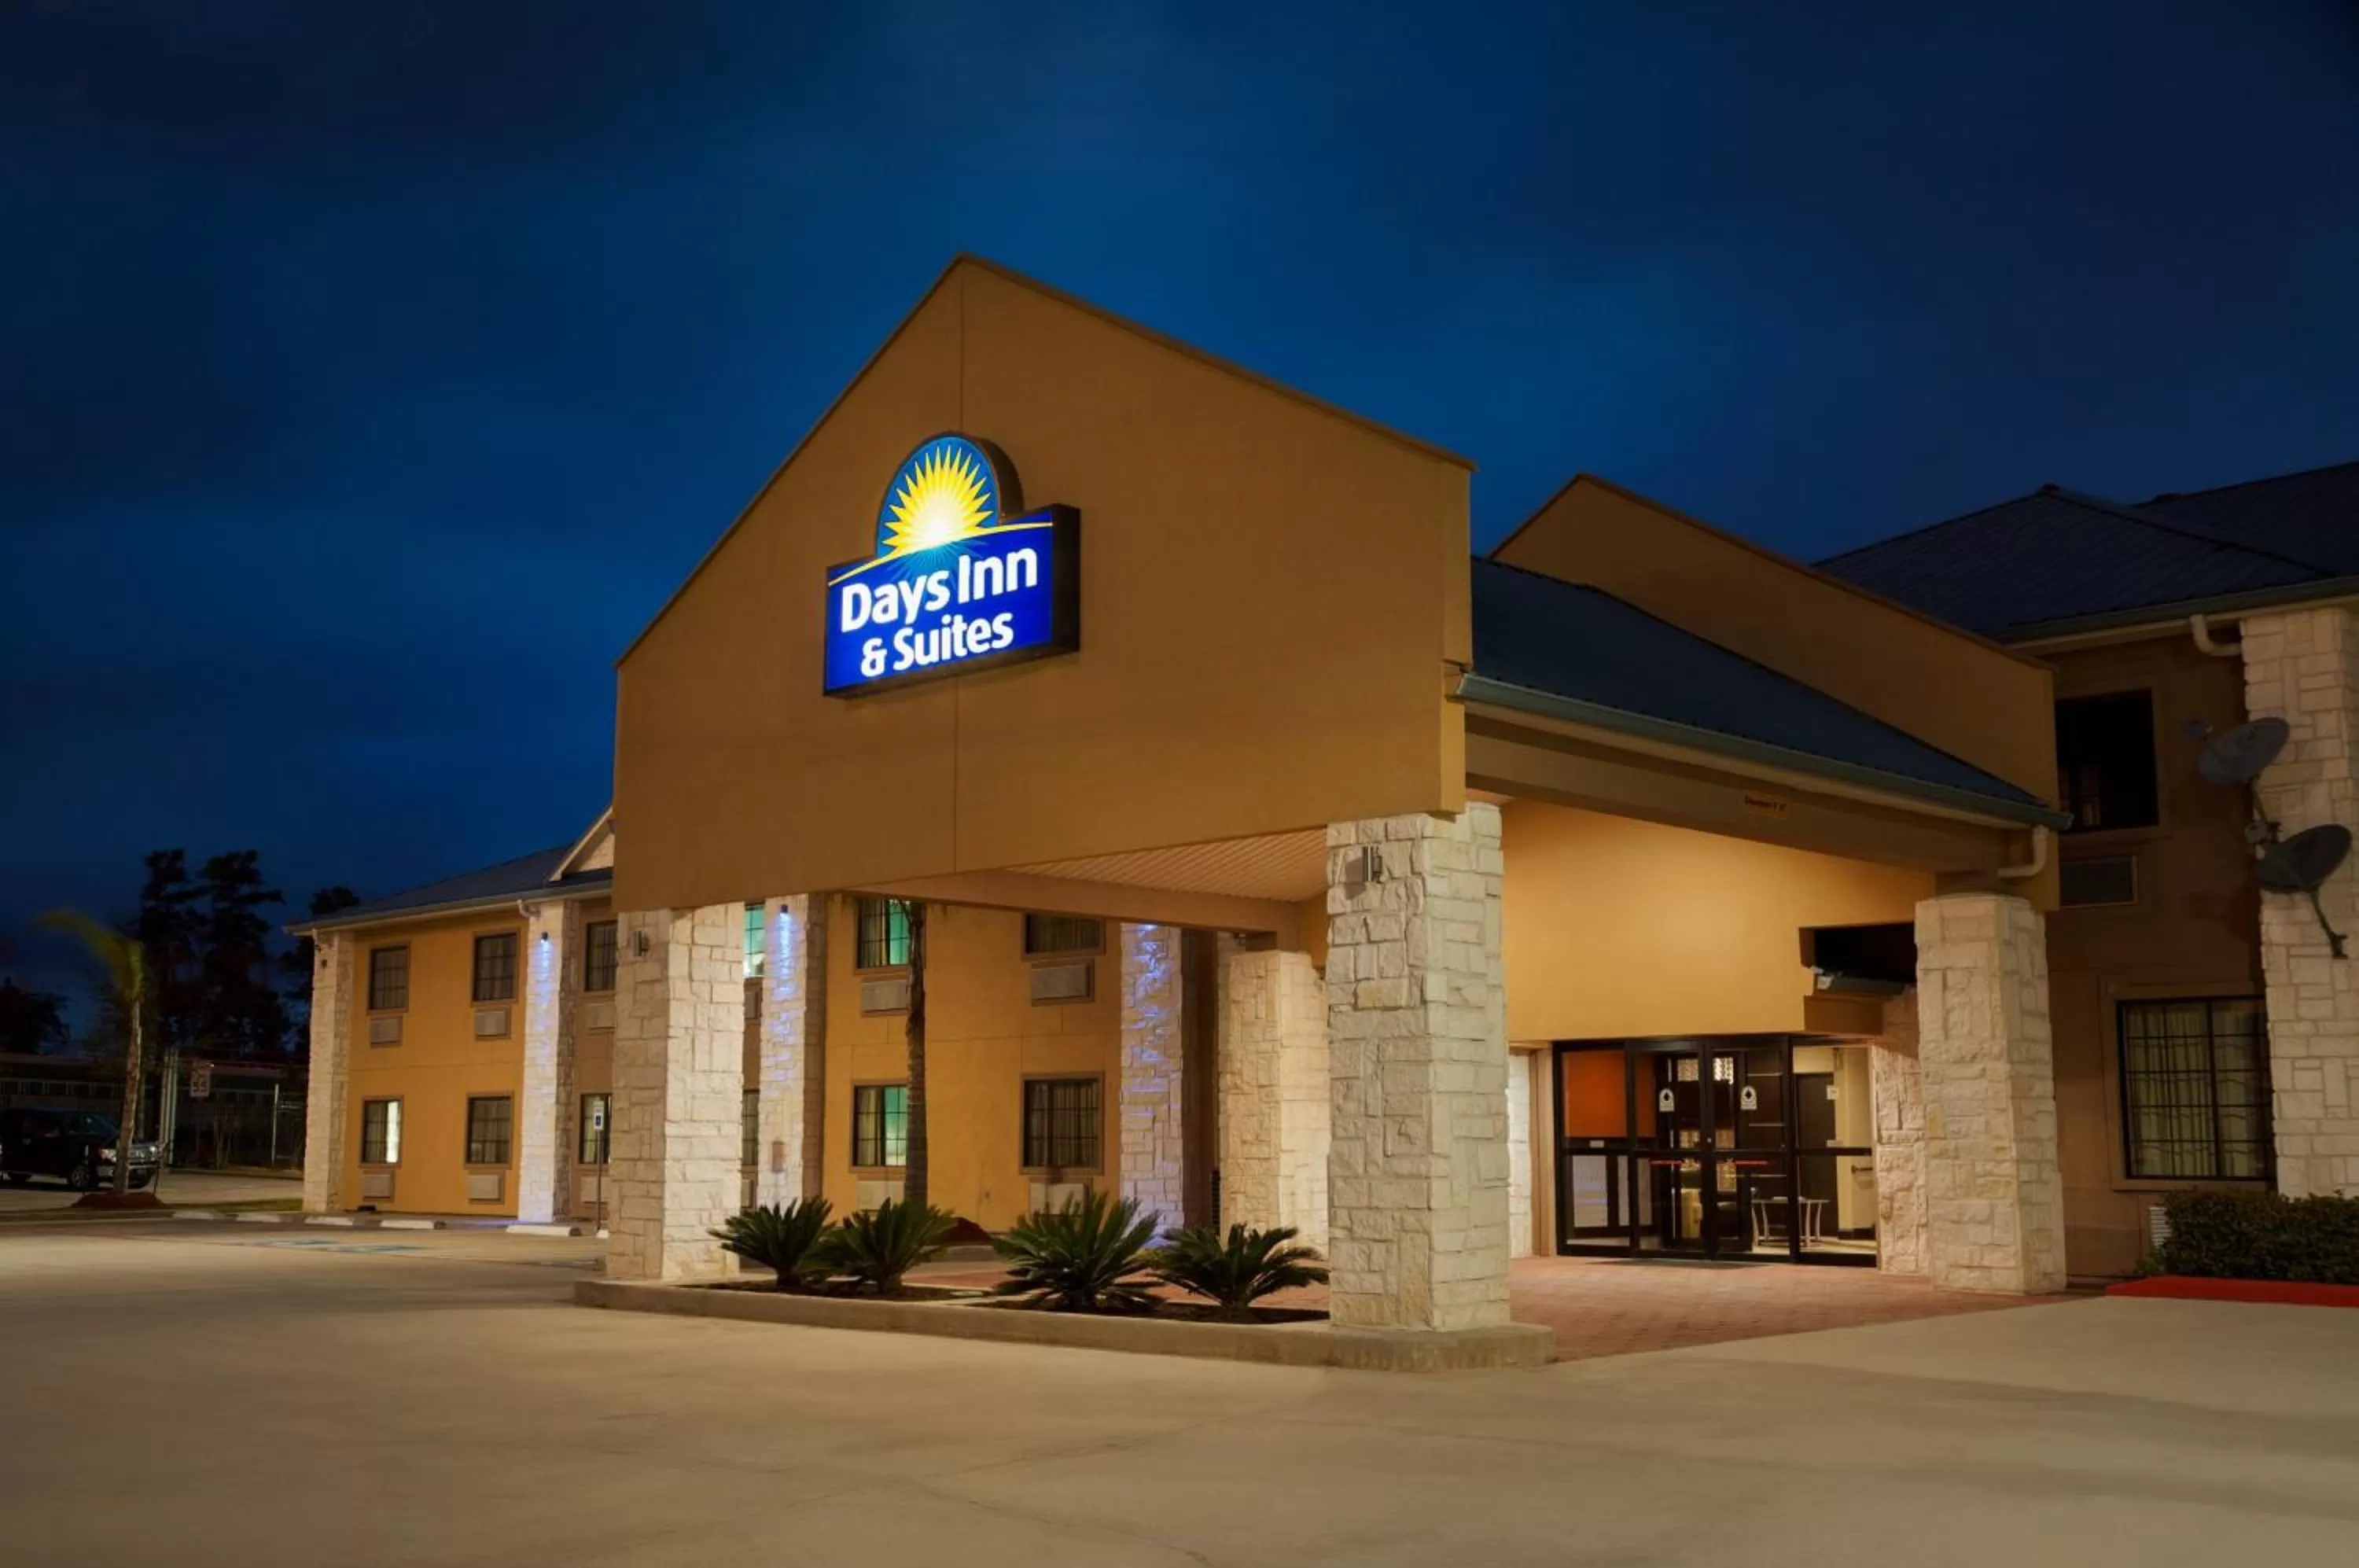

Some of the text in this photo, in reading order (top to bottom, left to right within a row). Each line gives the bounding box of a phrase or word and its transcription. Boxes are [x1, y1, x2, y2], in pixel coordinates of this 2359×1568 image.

[841, 547, 1037, 633] Days Inn
[860, 613, 1014, 677] & Suites
